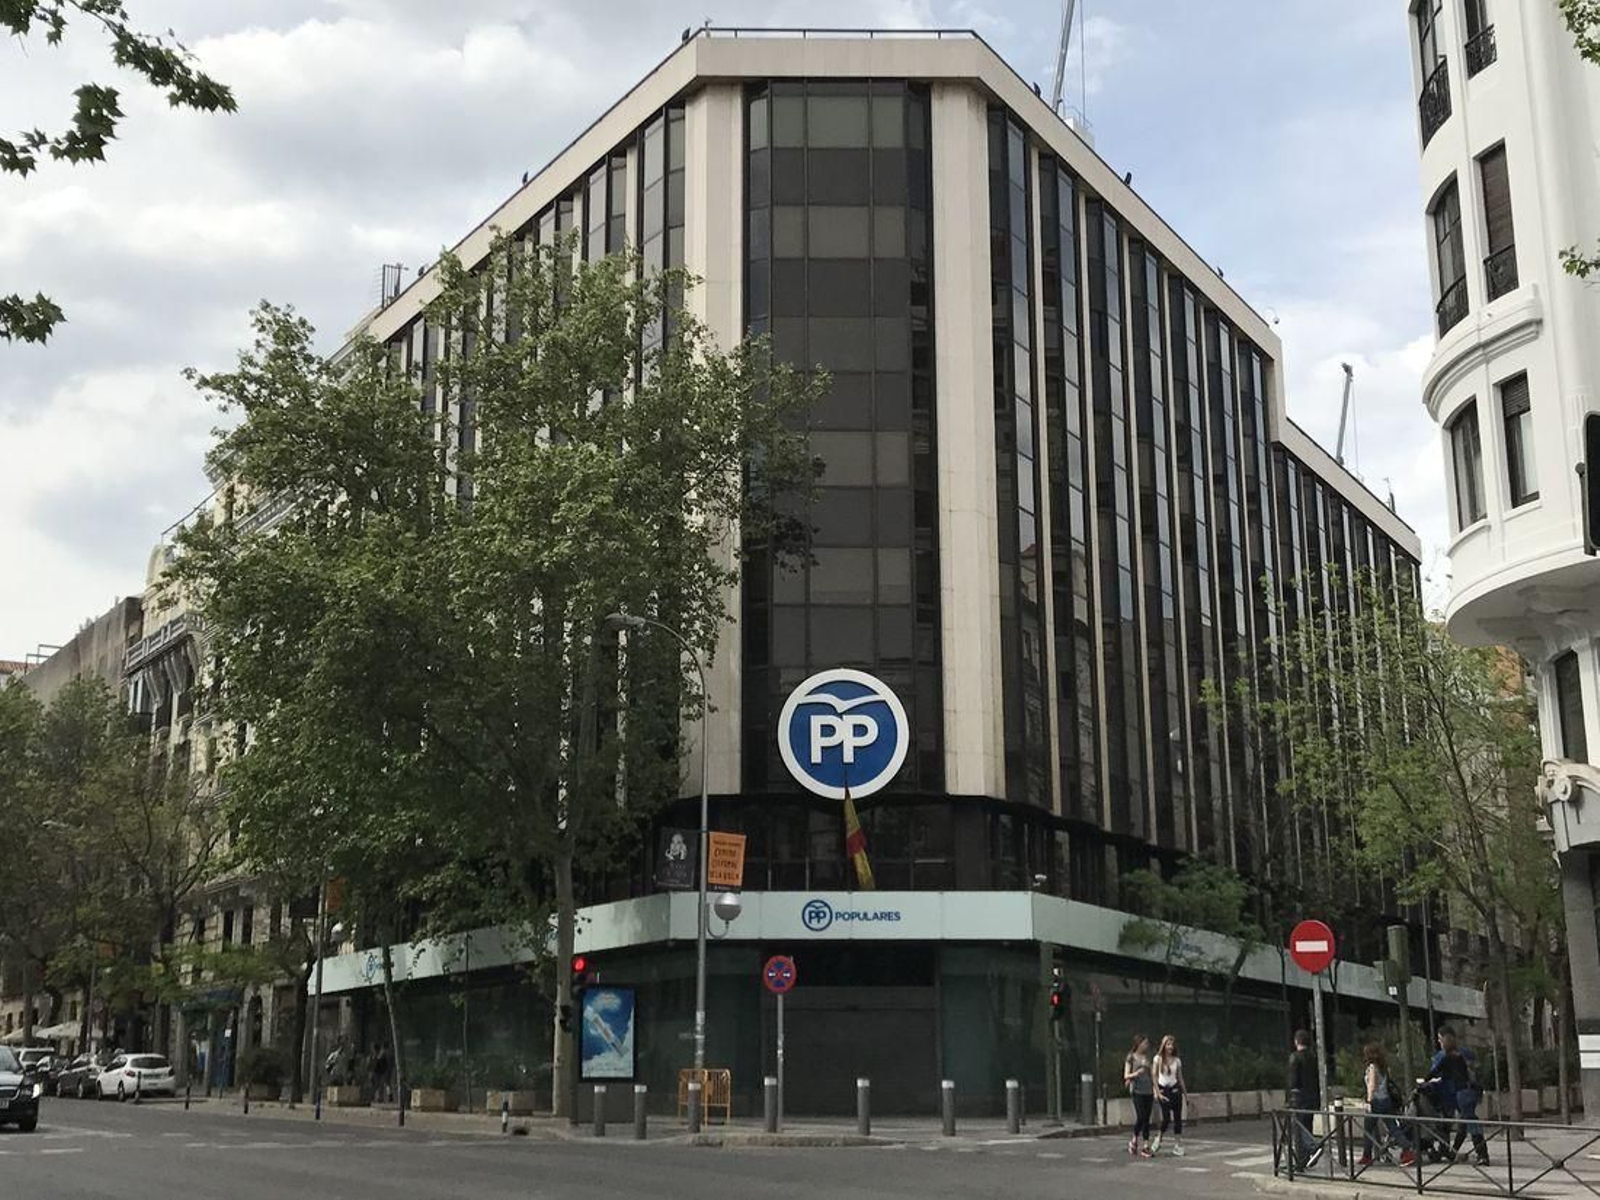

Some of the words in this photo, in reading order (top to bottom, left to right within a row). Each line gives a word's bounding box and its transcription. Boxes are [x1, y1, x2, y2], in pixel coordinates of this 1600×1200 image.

[810, 714, 879, 764] PP
[808, 910, 827, 924] PP
[834, 911, 901, 921] POPULARES
